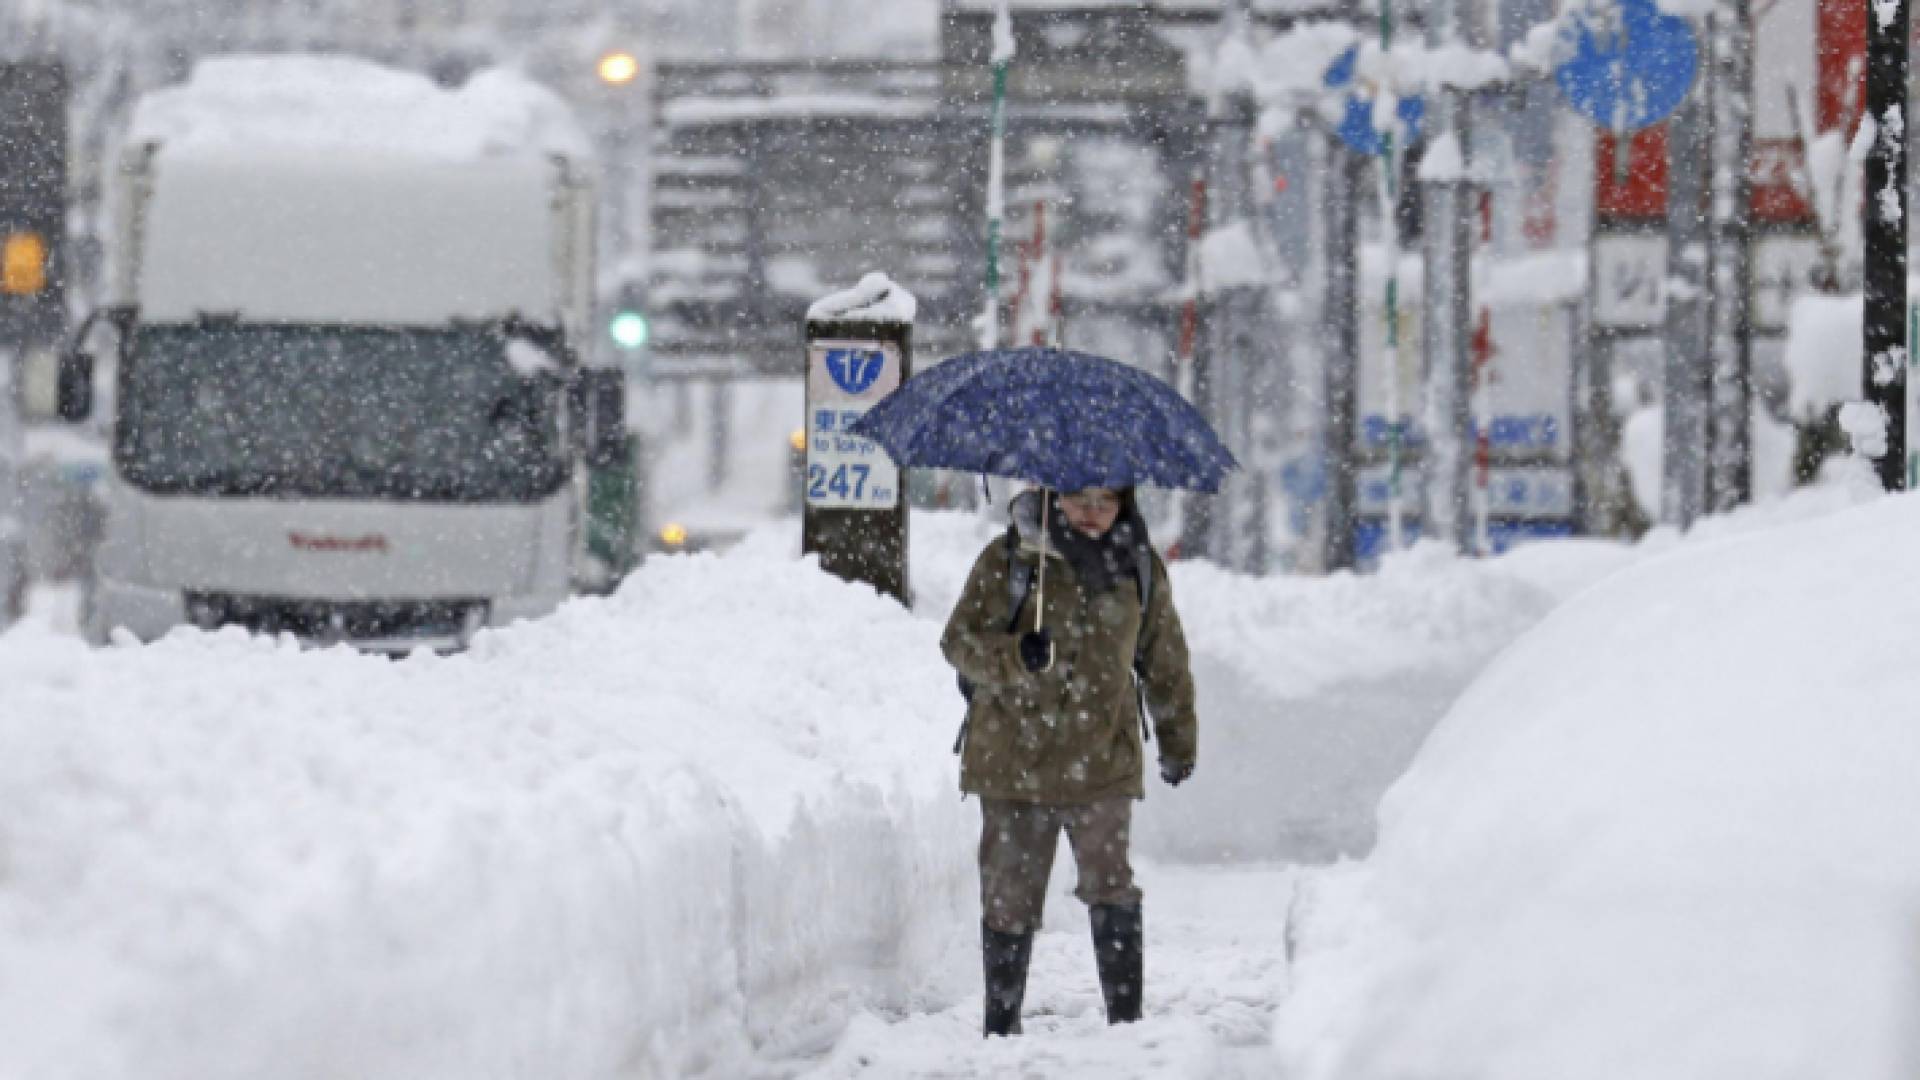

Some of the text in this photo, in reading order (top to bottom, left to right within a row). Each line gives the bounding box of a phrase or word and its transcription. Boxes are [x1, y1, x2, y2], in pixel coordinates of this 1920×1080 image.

[839, 353, 870, 385] 17
[815, 437, 875, 456] to Tokyo
[809, 463, 871, 500] 247
